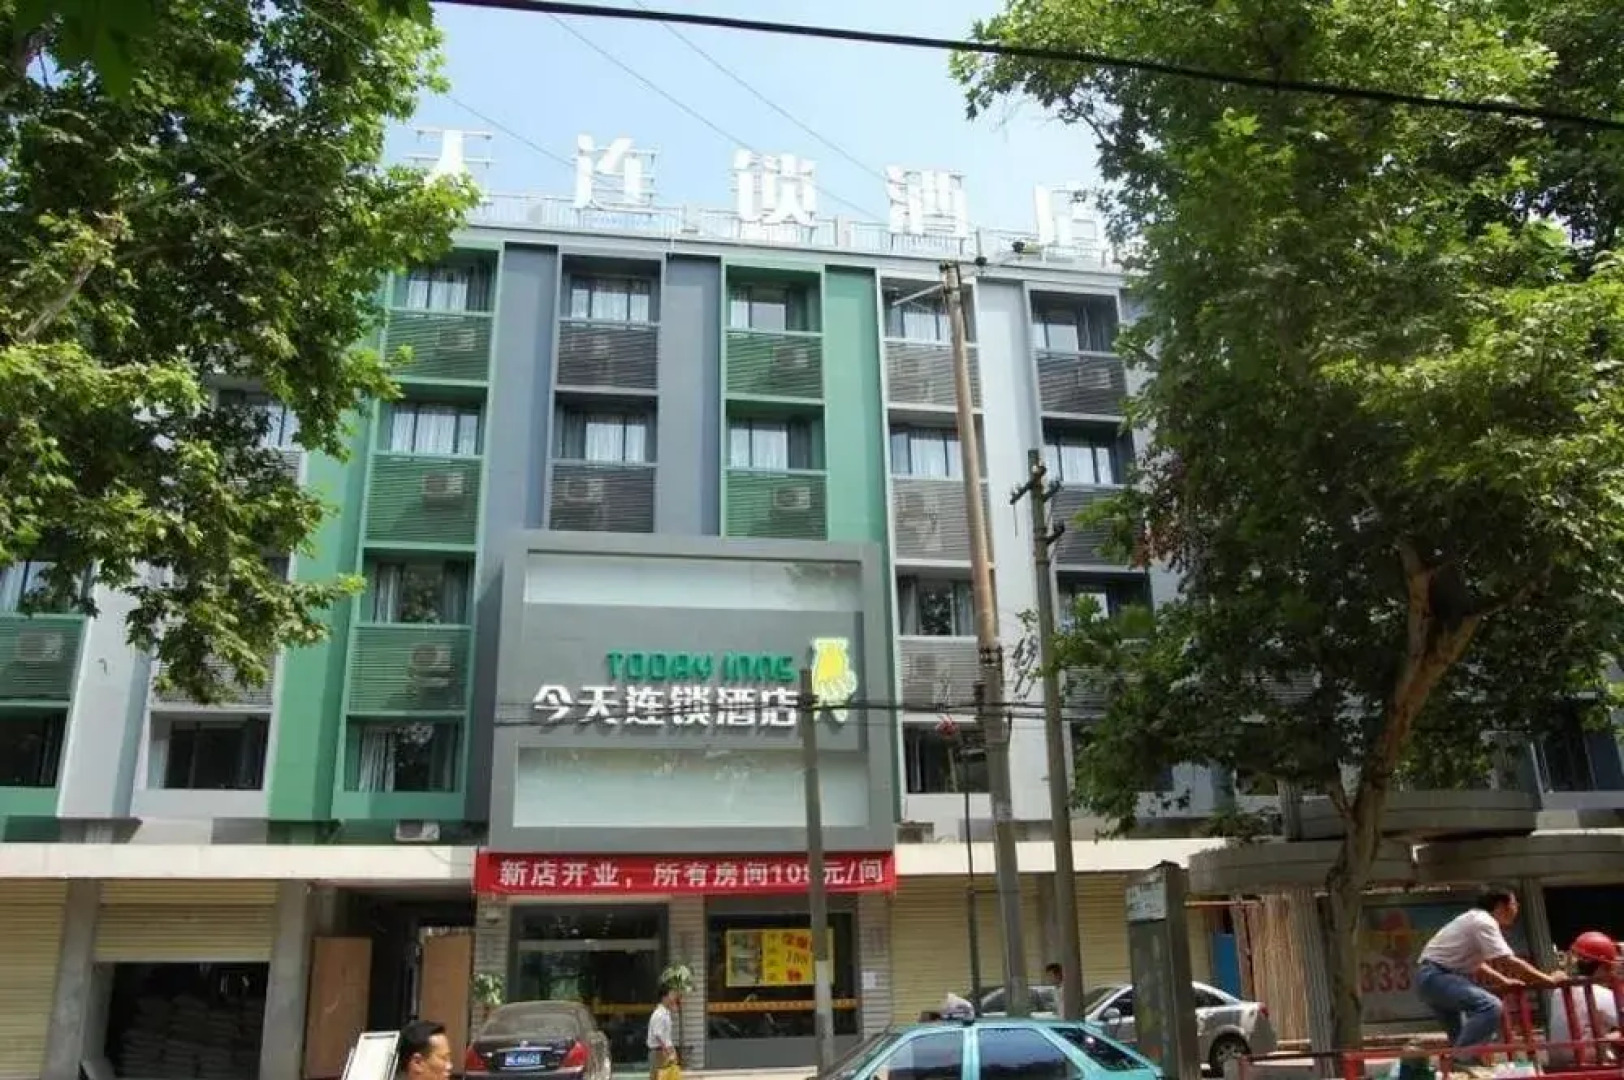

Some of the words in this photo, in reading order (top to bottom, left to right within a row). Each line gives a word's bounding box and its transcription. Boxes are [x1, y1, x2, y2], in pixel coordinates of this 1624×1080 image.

[607, 651, 712, 682] TODAY
[532, 685, 798, 726] 今天连锁酒店
